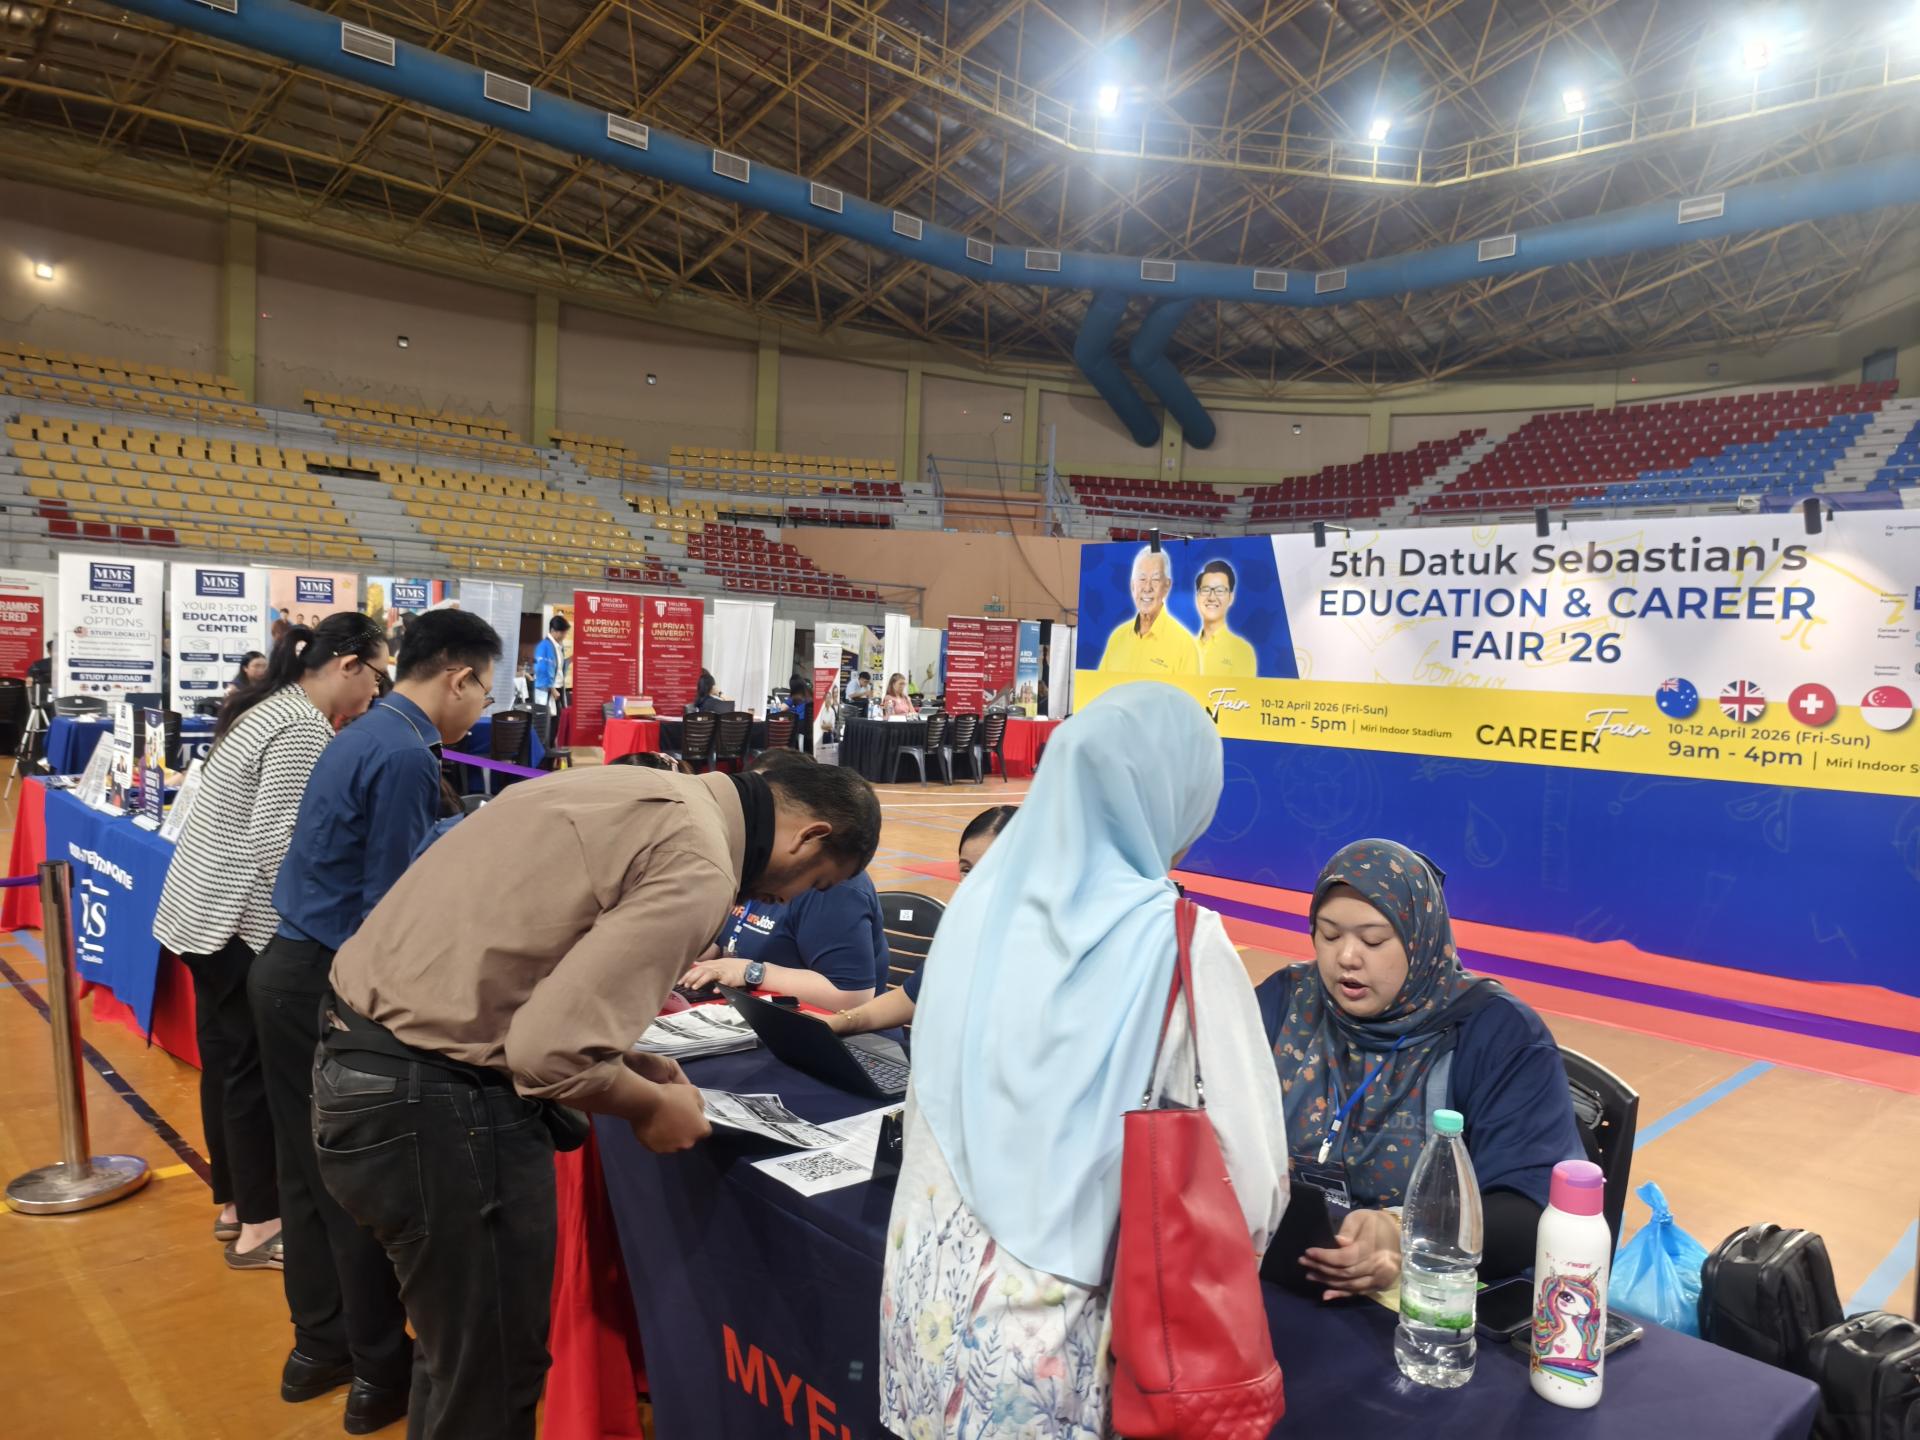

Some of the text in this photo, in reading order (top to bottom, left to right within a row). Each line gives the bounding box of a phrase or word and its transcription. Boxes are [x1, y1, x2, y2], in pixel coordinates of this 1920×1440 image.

[1329, 537, 1808, 577] 5th Datuk Sebastian's
[94, 568, 132, 580] MMS
[202, 575, 239, 588] MMS
[300, 581, 331, 592] MMS
[81, 594, 143, 605] FLEXIBLE
[395, 588, 425, 598] MMS
[90, 605, 134, 616] STUDY
[182, 602, 216, 610] YOUR
[1319, 586, 1817, 621] EDUCATION & CAREER
[83, 616, 144, 627] OPTIONS
[182, 612, 258, 623] EDUCATION
[596, 619, 631, 628] PRIVATE
[197, 624, 247, 633] CENTRE
[583, 626, 631, 634] UNIVERSITY
[1451, 630, 1622, 663] FAIR '26
[1208, 688, 1250, 717] Fair
[1260, 699, 1388, 717] 10-12 April 2026 (Fri-Sun)
[1260, 713, 1296, 729] 11am
[1310, 716, 1347, 733] 5pm
[1584, 708, 1651, 747] Fair
[1360, 723, 1453, 739] Miri Indoor Stadium
[1668, 722, 1871, 750] 10-12 April 2026 (Fri-Sun)
[1475, 724, 1602, 754] CAREER
[1667, 740, 1720, 760] 9am
[1744, 746, 1804, 768] 4pm
[1825, 757, 1854, 770] Miri
[1856, 759, 1907, 774] Indoor
